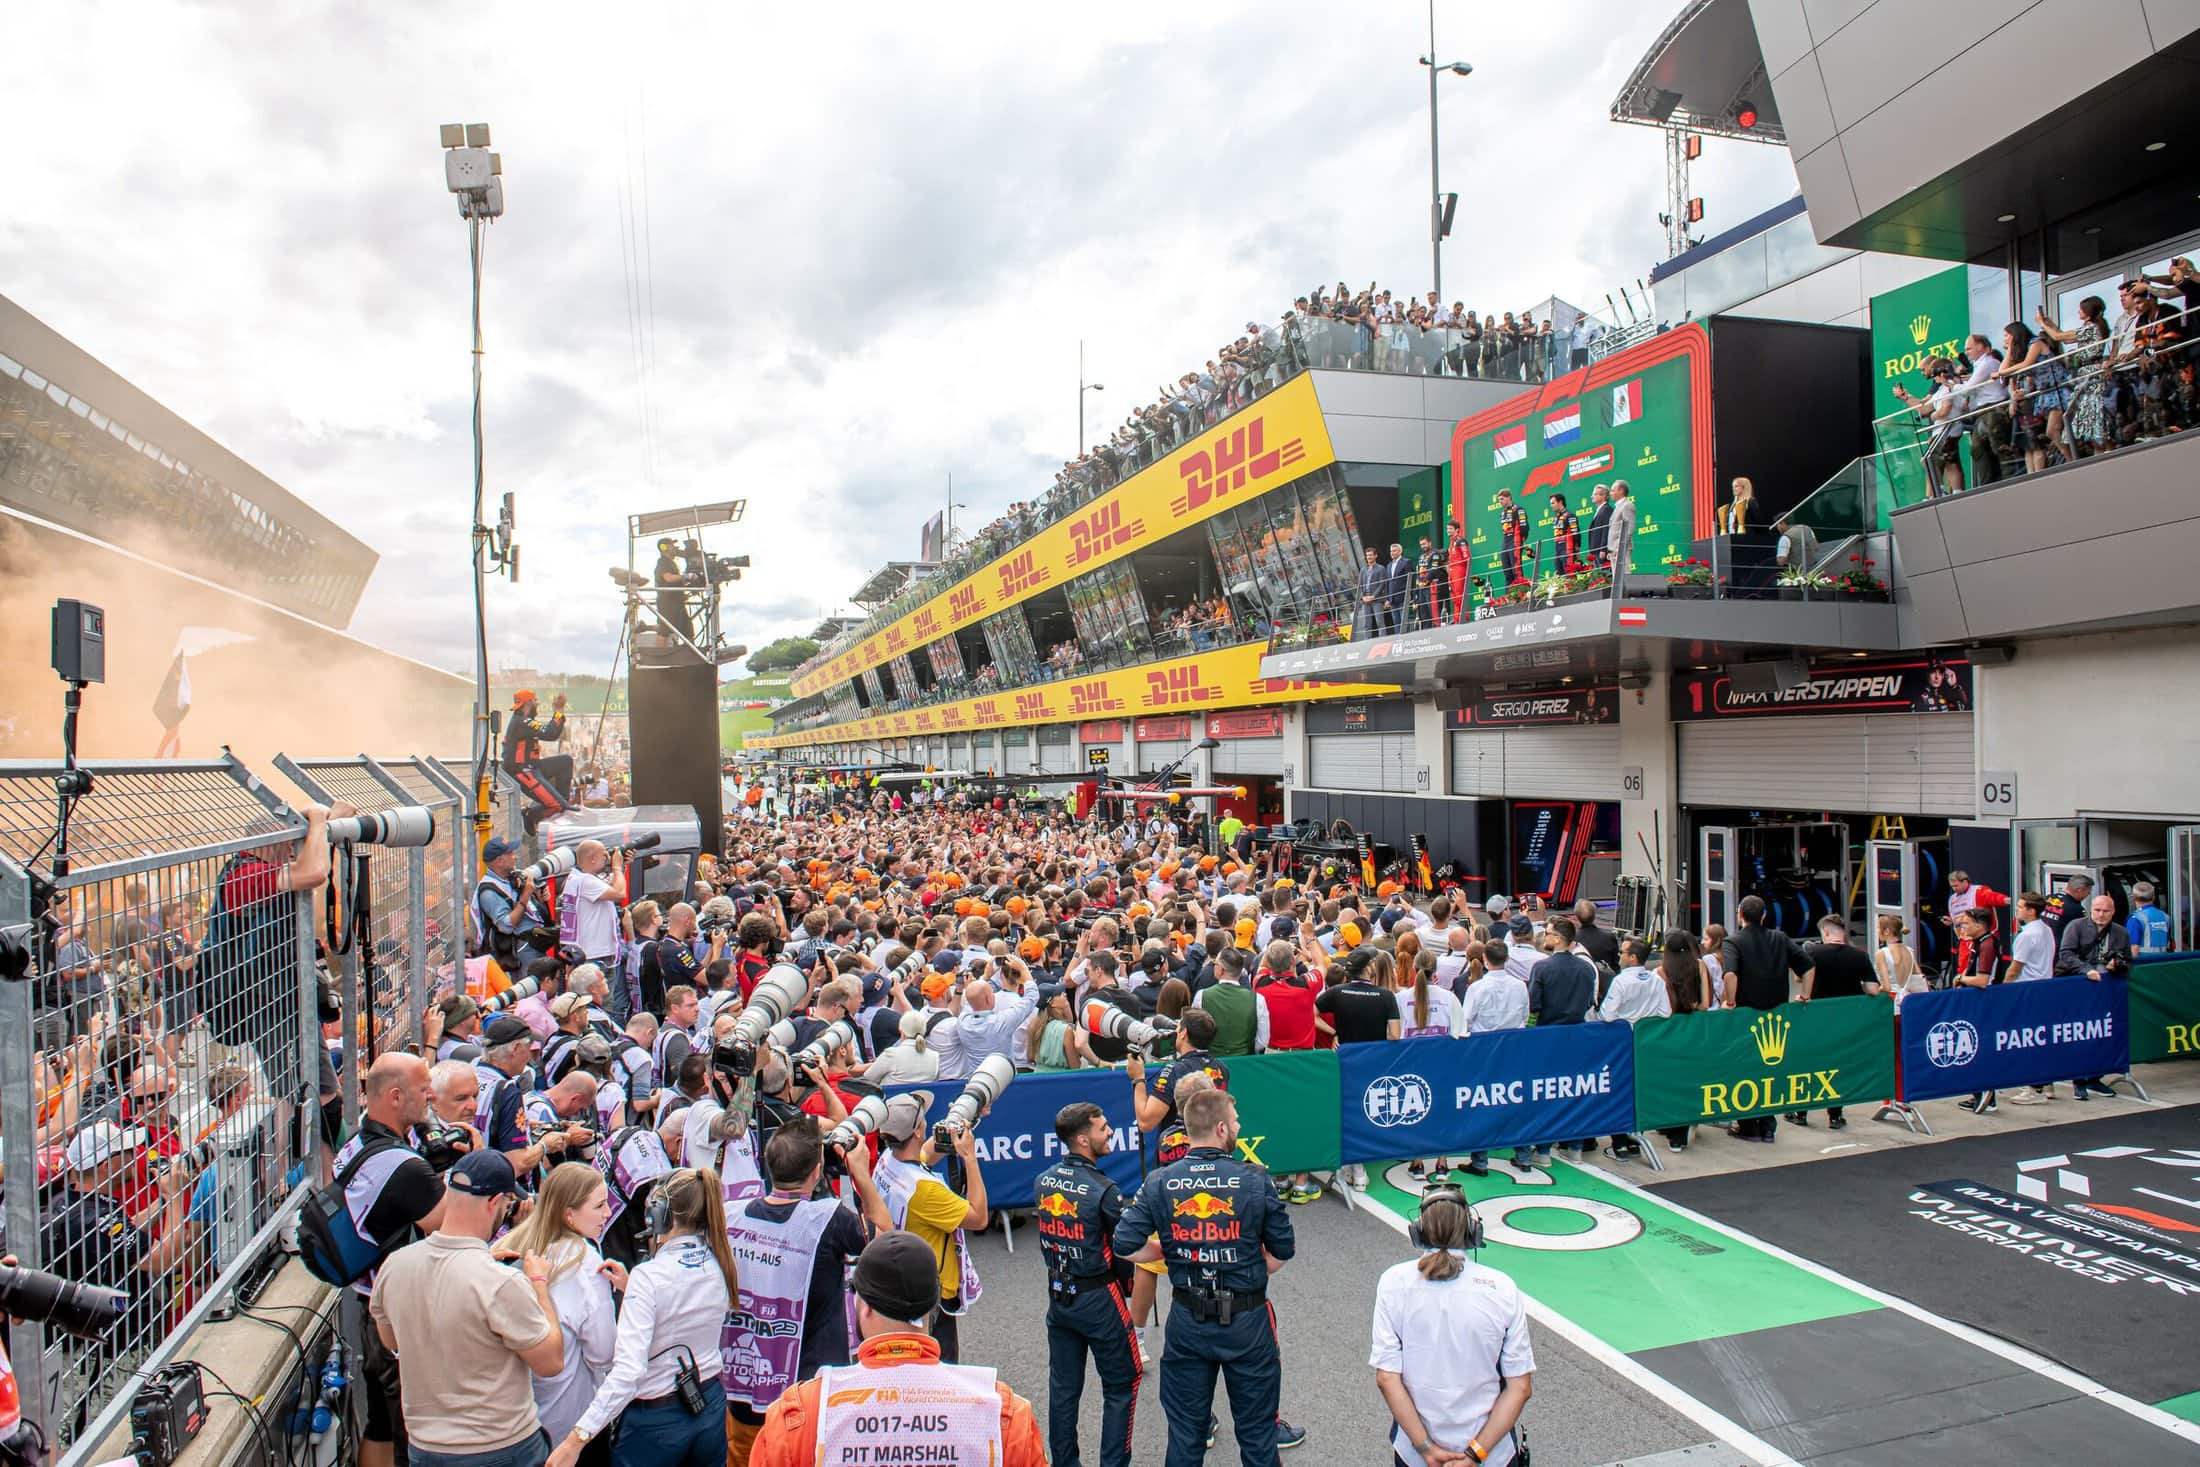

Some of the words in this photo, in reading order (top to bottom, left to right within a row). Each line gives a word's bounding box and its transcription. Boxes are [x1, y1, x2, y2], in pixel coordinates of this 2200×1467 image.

[1180, 416, 1280, 511] DHL
[1638, 455, 1658, 467] ROLEX
[1660, 483, 1681, 495] ROLEX
[1069, 499, 1131, 564] DHL
[998, 550, 1041, 598] DHL
[949, 584, 980, 622] DHL
[913, 608, 938, 640] DHL
[1070, 681, 1115, 714] DHL
[1147, 665, 1209, 705] DHL
[974, 700, 1001, 724] DHL
[1016, 692, 1050, 719] DHL
[1492, 702, 1531, 717] SERGIO
[1531, 699, 1570, 715] PEREZ
[1417, 770, 1428, 784] 07
[1623, 775, 1641, 791] 06
[1983, 783, 2012, 803] 05
[1996, 1029, 2047, 1052] PARC
[2053, 1012, 2113, 1045] FERMÉ
[1455, 1080, 1525, 1110] PARC
[1532, 1064, 1612, 1101] FERMÉ
[1700, 1069, 1841, 1116] ROLEX
[974, 1133, 1032, 1162] ARC
[1041, 1176, 1090, 1196] ORACLE
[1166, 1177, 1240, 1190] ORACLE
[1954, 1187, 2033, 1212] MAX
[1057, 1221, 1084, 1240] Bull
[1171, 1221, 1202, 1241] Red
[1205, 1220, 1241, 1241] Bull
[1908, 1191, 2200, 1296] WINNER
[1908, 1209, 2036, 1254] AUSTRIA
[2032, 1252, 2128, 1284] 2023
[733, 1247, 782, 1266] 1141-AUS
[855, 1415, 948, 1433] 0017-AUS
[842, 1446, 869, 1462] PIT
[874, 1446, 959, 1461] MARSHAL
